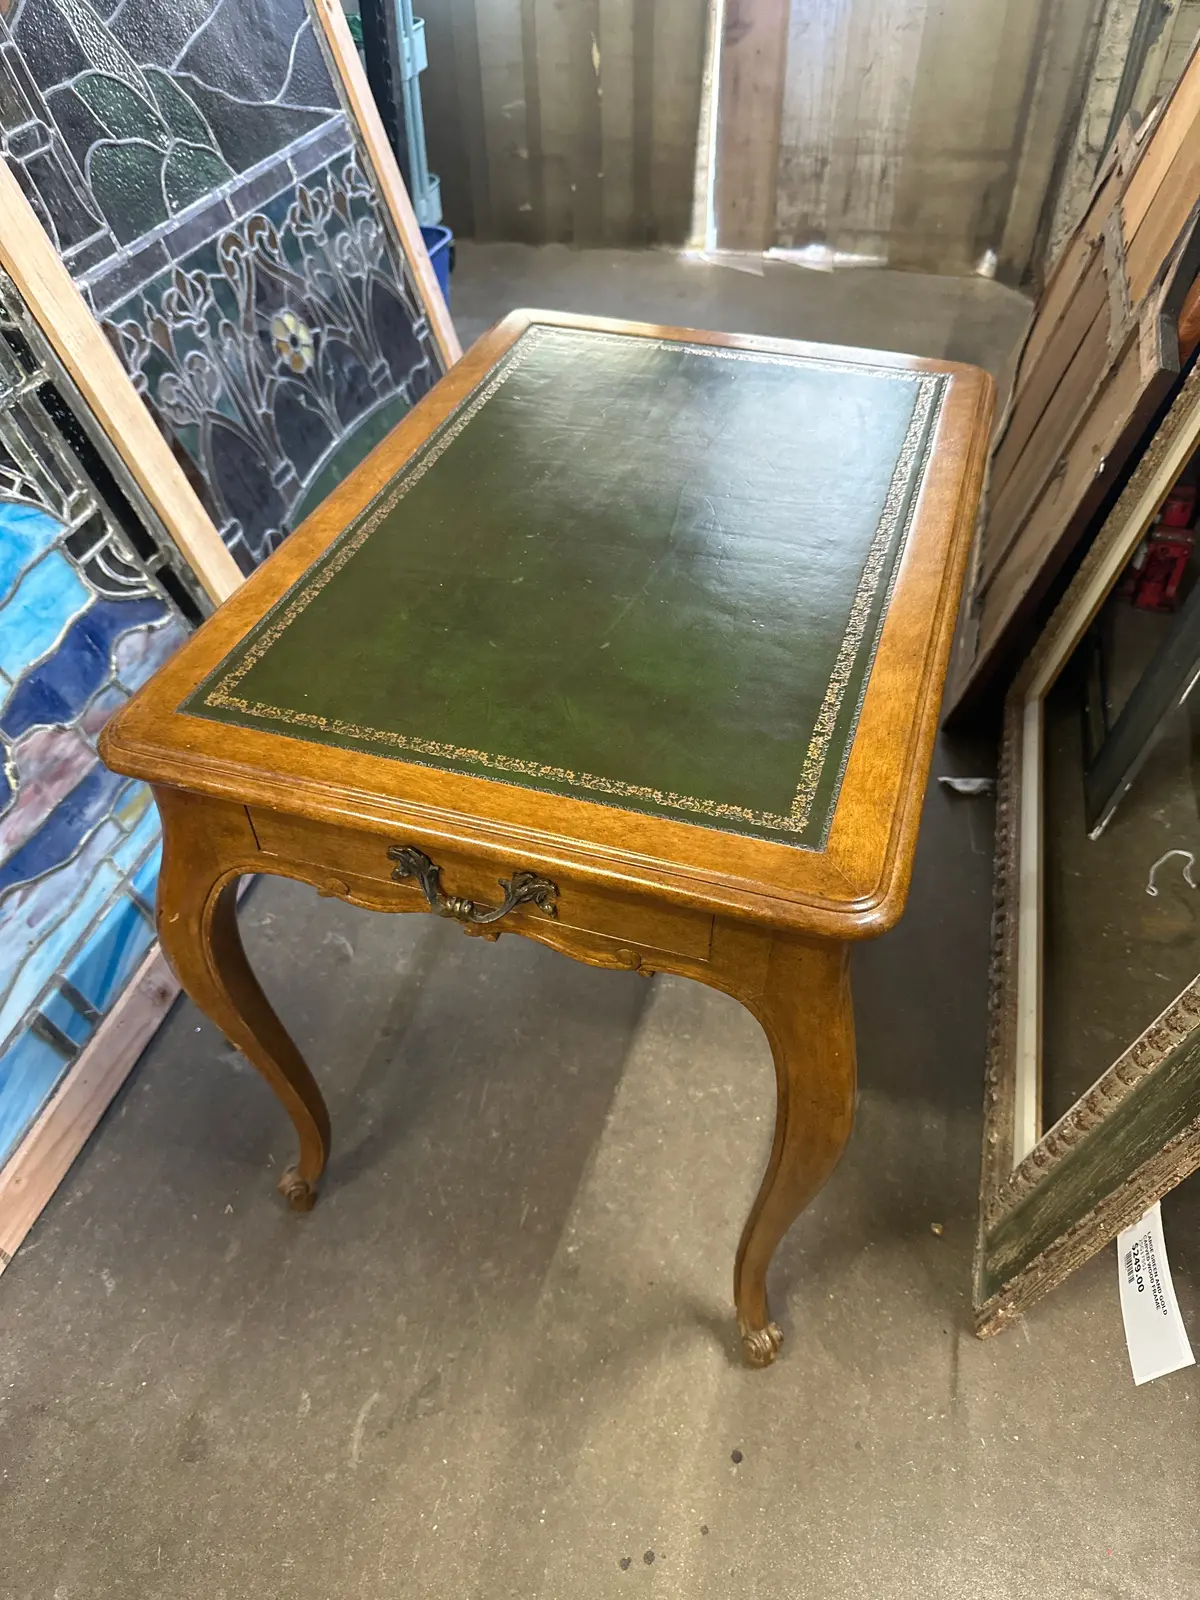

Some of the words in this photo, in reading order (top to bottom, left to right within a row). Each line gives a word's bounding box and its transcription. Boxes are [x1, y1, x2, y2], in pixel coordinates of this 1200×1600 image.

[1131, 1242, 1145, 1293] $249.00
[1150, 1254, 1158, 1278] GREEN
[1159, 1295, 1168, 1315] GOLD
[1152, 1284, 1161, 1310] FRAME
